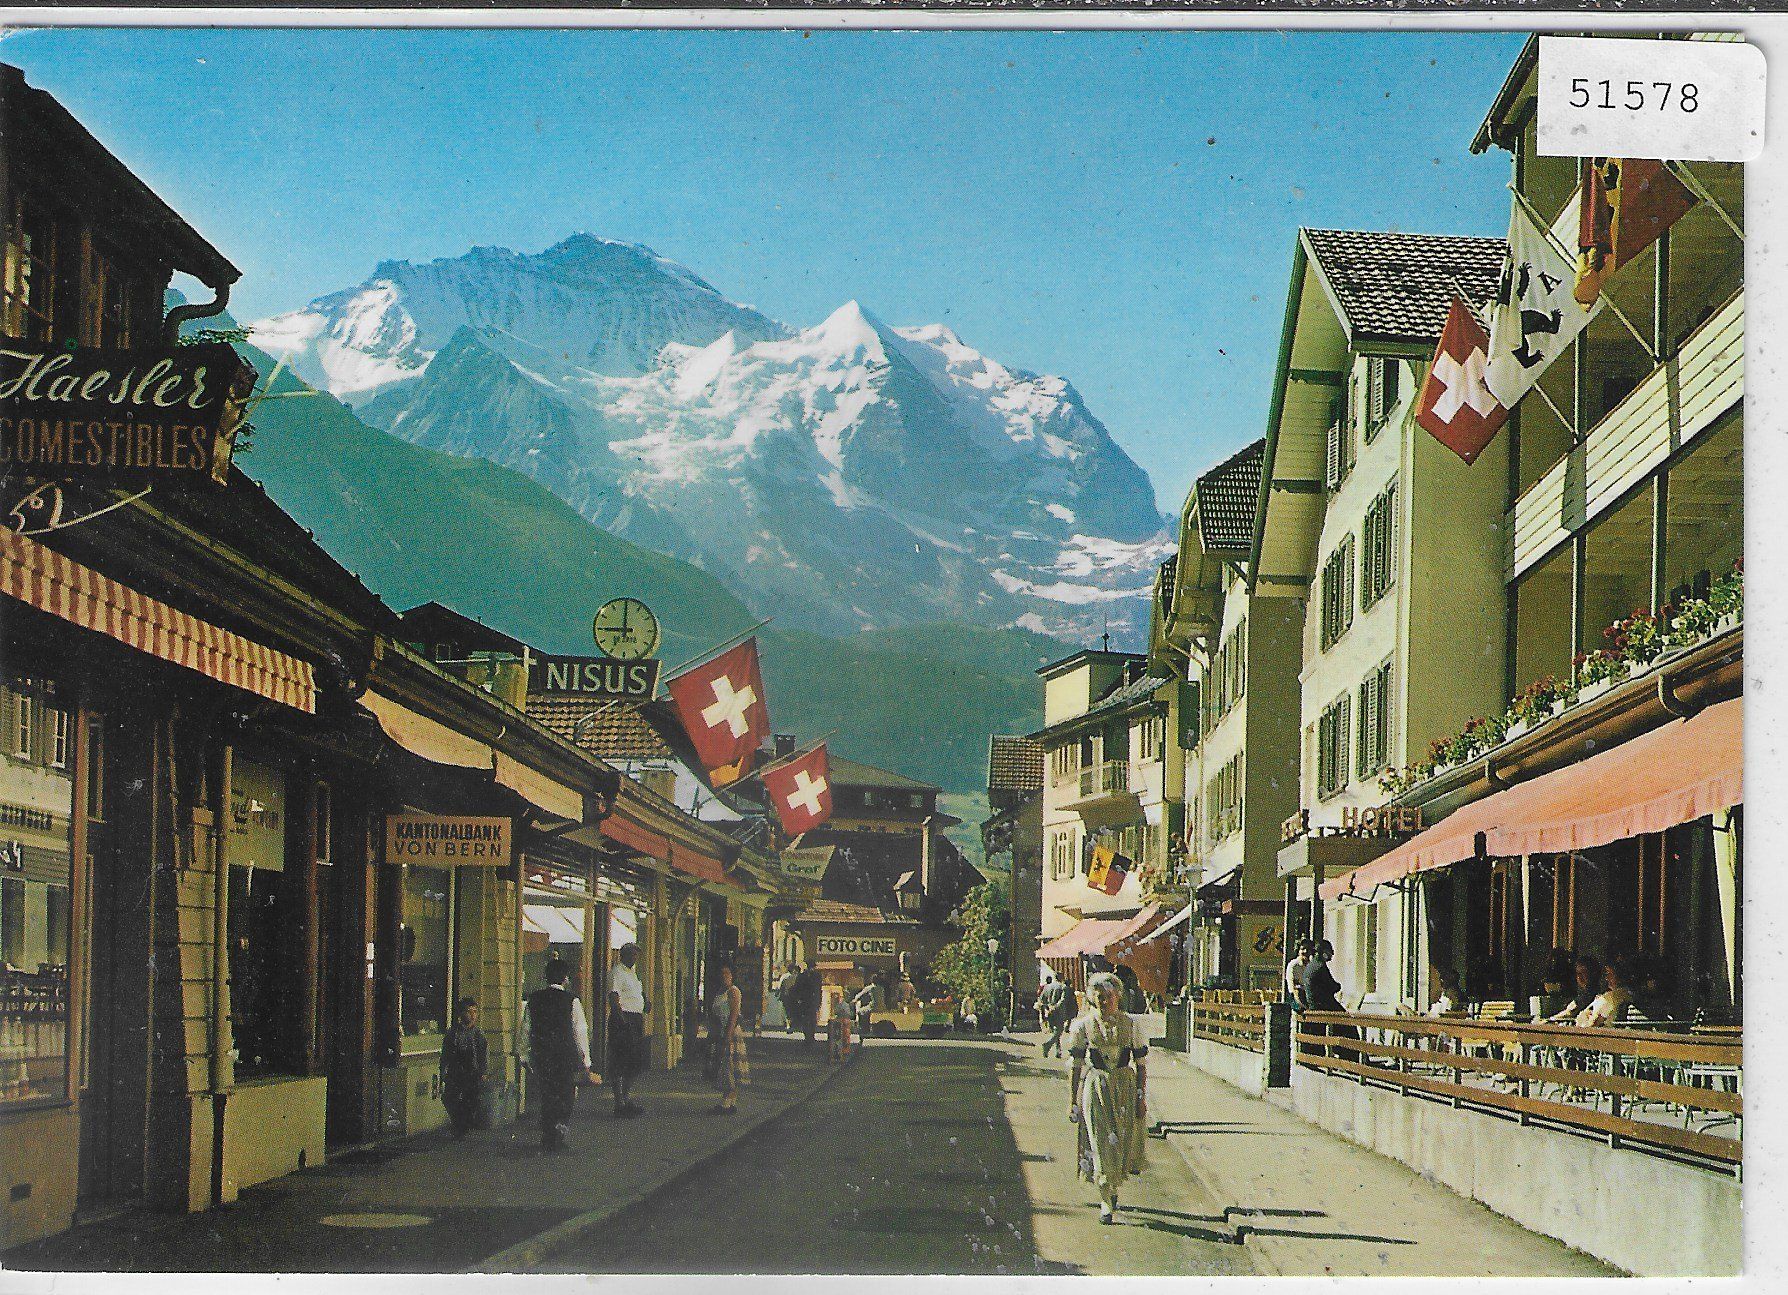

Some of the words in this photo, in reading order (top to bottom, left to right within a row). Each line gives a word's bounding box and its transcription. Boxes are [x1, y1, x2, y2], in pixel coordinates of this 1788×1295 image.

[1569, 78, 1699, 113] 51578
[0, 350, 214, 409] Haesler
[0, 416, 207, 469] COMESTIBLES
[547, 662, 647, 694] NISUS
[396, 822, 502, 841] KANTONALBANK
[1342, 806, 1428, 832] HOTEL
[394, 840, 437, 856] VON
[444, 842, 502, 858] BERN
[819, 939, 857, 952] FOTO
[861, 940, 894, 954] CINE
